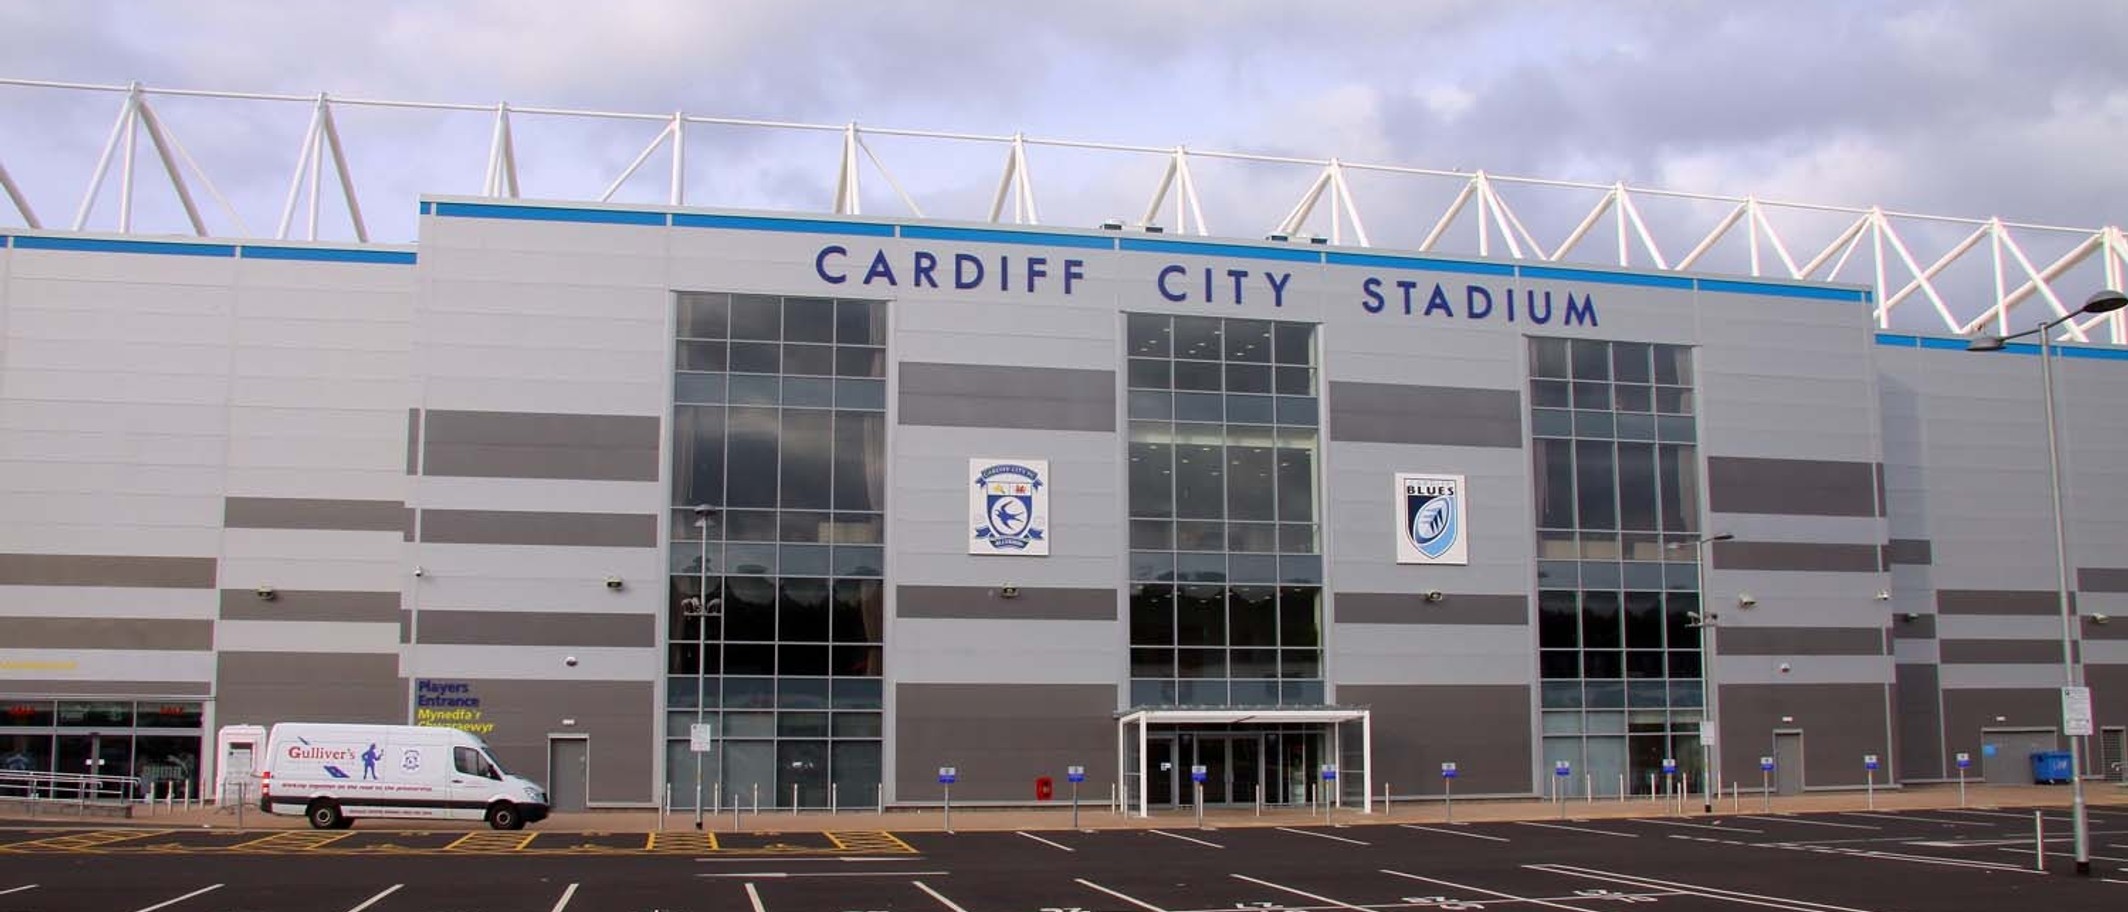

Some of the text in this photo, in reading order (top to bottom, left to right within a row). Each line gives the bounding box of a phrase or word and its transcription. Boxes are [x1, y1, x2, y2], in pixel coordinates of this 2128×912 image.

[815, 245, 1598, 327] CARDIFF CITY STADIUM
[1407, 486, 1454, 495] BLUES
[418, 680, 469, 695] Players
[418, 695, 480, 707] Entrance
[288, 746, 355, 760] Gulliver's
